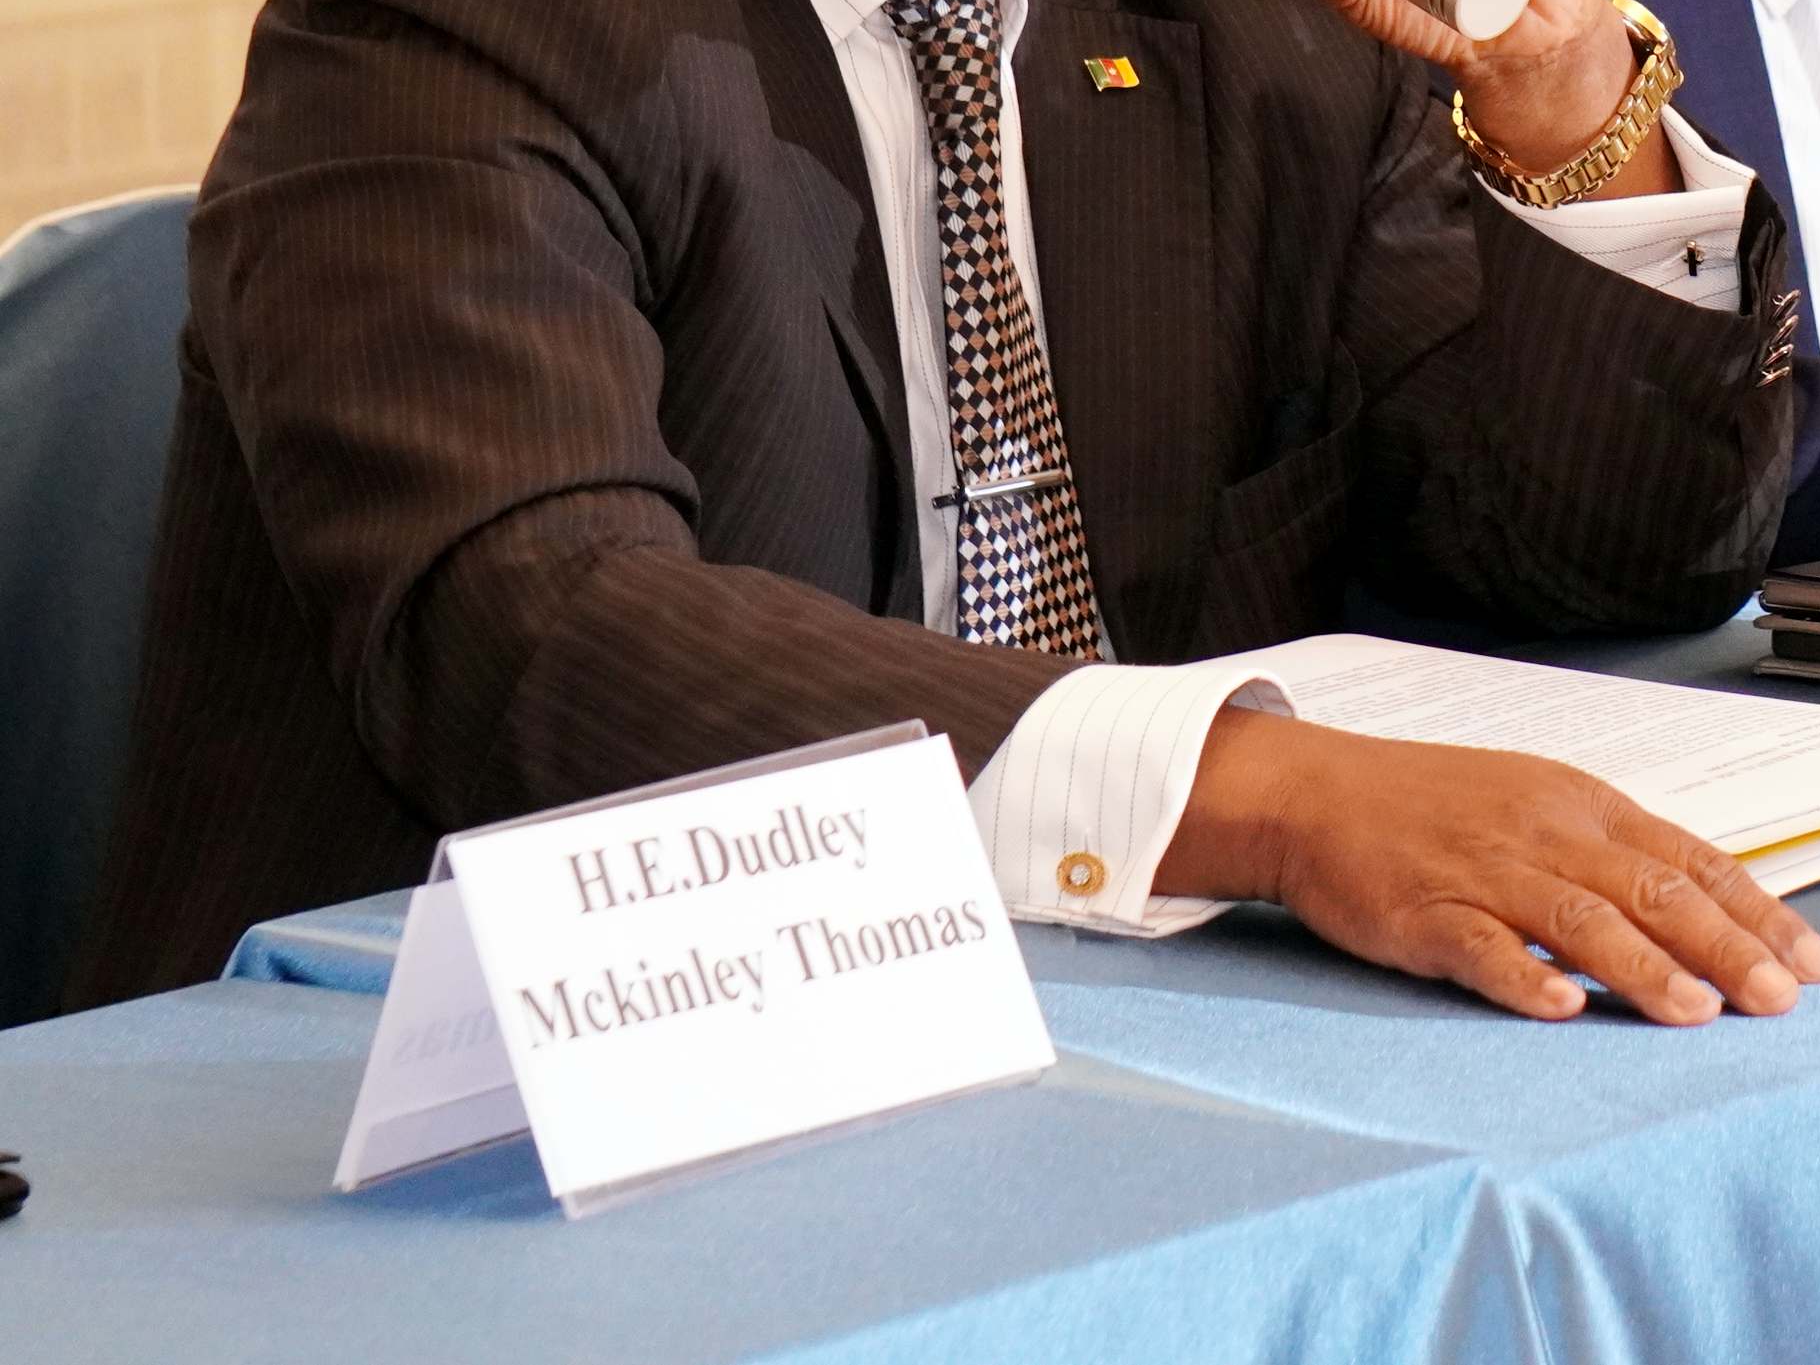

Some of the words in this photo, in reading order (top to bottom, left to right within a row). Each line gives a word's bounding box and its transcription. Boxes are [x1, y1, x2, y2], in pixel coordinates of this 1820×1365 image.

[566, 804, 867, 914] H.E.Dudley
[516, 948, 764, 1048] Mckinley
[775, 898, 988, 983] Thomas
